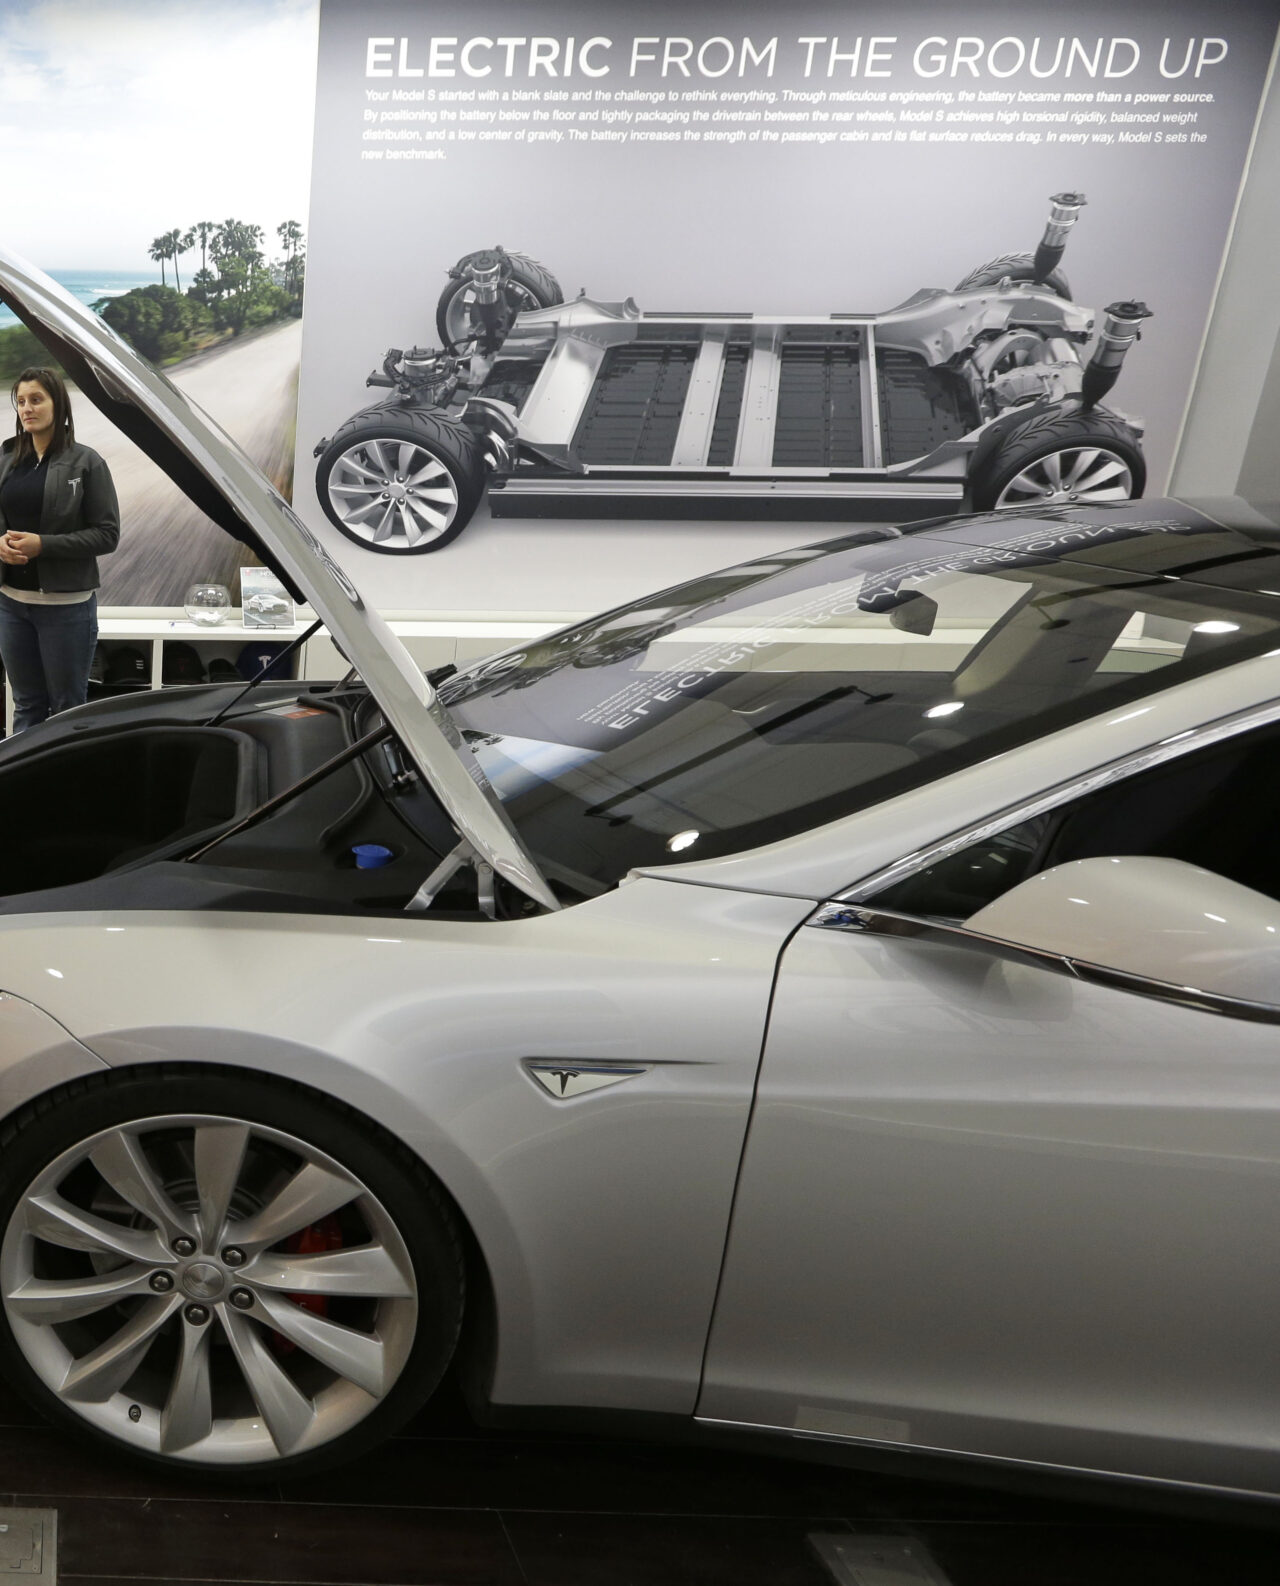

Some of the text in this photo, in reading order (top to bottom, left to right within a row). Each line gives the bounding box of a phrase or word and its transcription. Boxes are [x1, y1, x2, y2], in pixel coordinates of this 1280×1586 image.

[365, 36, 1229, 79] ELECTRIC FROM THE GROUND UP
[365, 89, 1215, 105] Your Model S started with a blank slate and the challenge to rethink everything. Through meticulous engineering, the battery became more than a power source.
[363, 109, 1198, 125] By positioning the battery below the floor and tightly packaging the drivetrain between the rear wheels, Model S achieves high torsional rigidity, balanced weight
[362, 129, 1208, 145] distribution, and a low center of gravity. The battery increases the strength of the passenger cabin and its flat surface reduces drag. In every way, Model S sets the
[361, 149, 446, 160] new benchmark.
